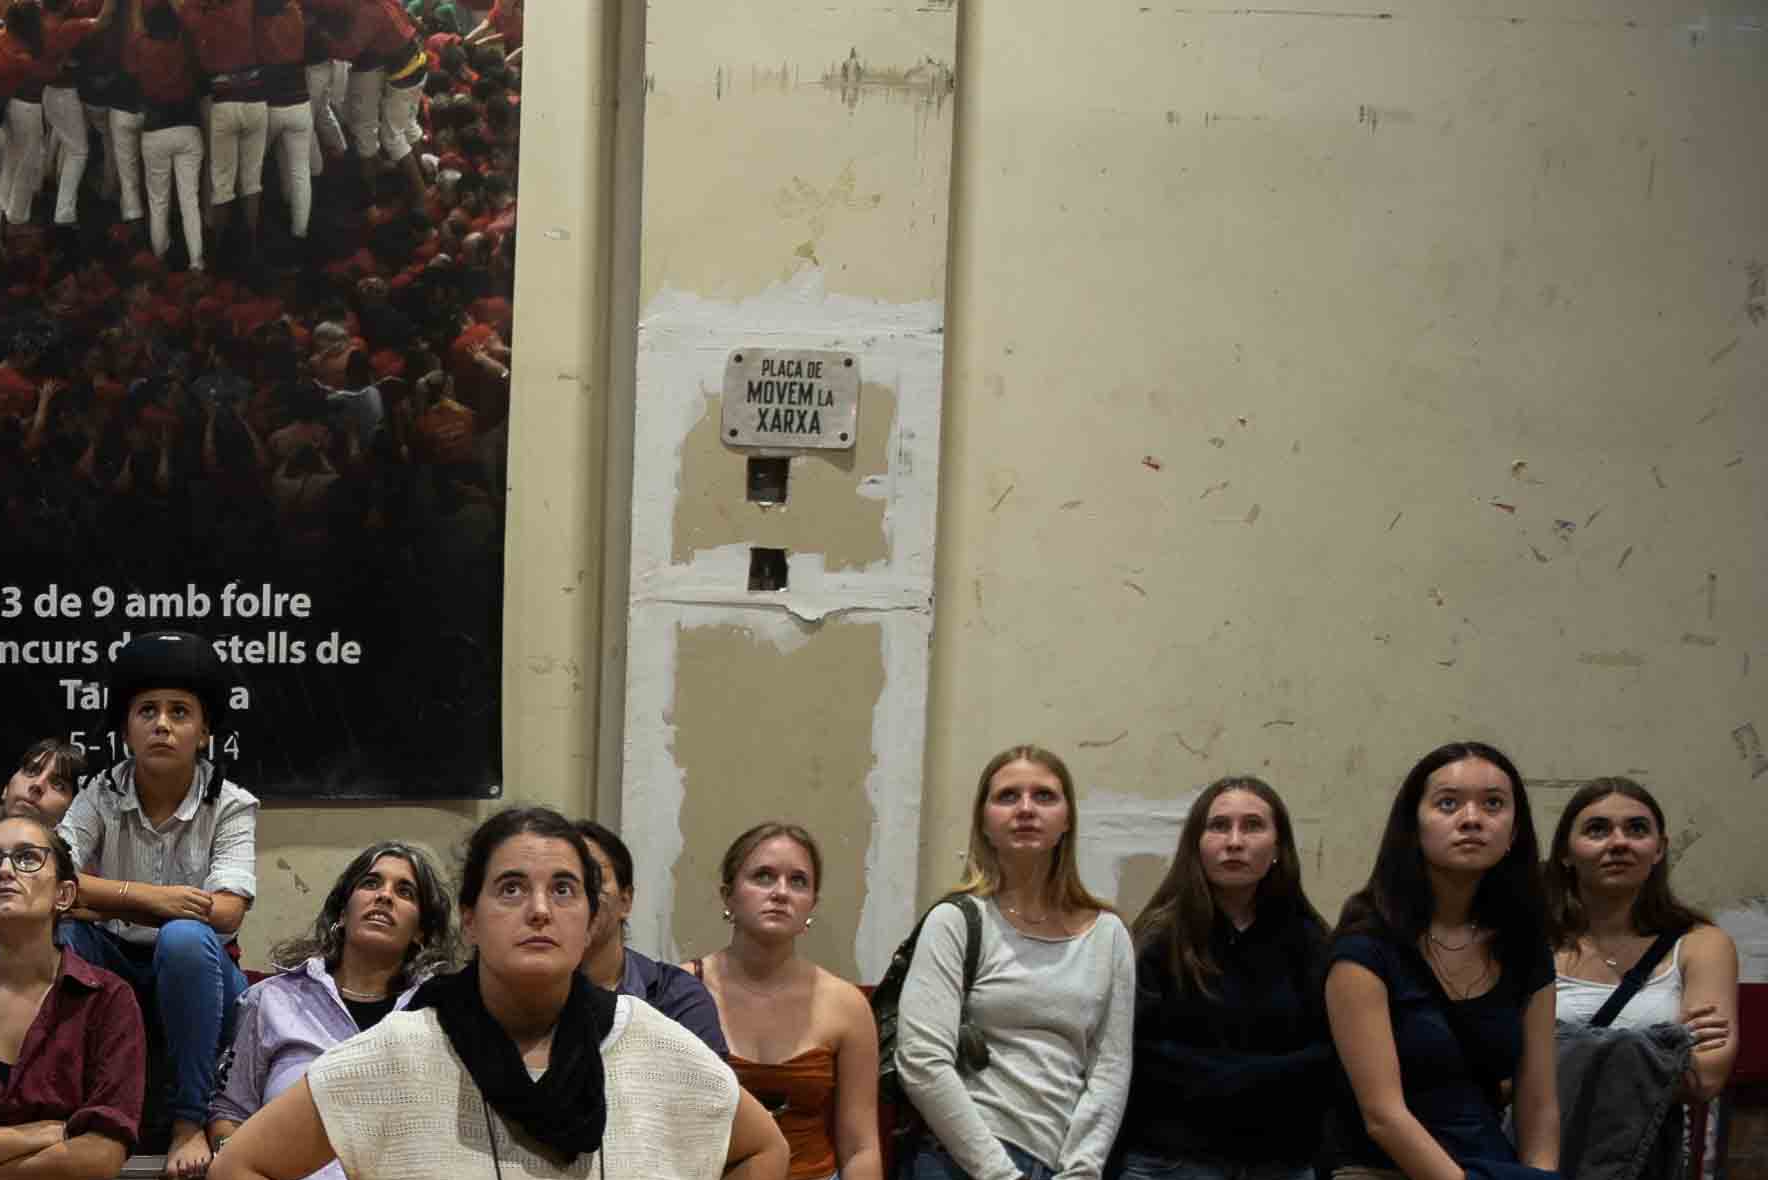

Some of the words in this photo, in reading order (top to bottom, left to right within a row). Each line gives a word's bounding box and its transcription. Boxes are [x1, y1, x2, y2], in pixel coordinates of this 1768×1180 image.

[806, 361, 823, 379] DE
[746, 380, 814, 406] MOVEM
[817, 389, 835, 407] LA
[755, 408, 822, 435] XARXA
[1, 586, 23, 618] 3
[33, 583, 82, 618] de
[91, 585, 115, 618] 9
[124, 583, 211, 618] amb
[220, 582, 312, 618] folre
[315, 631, 362, 664] de
